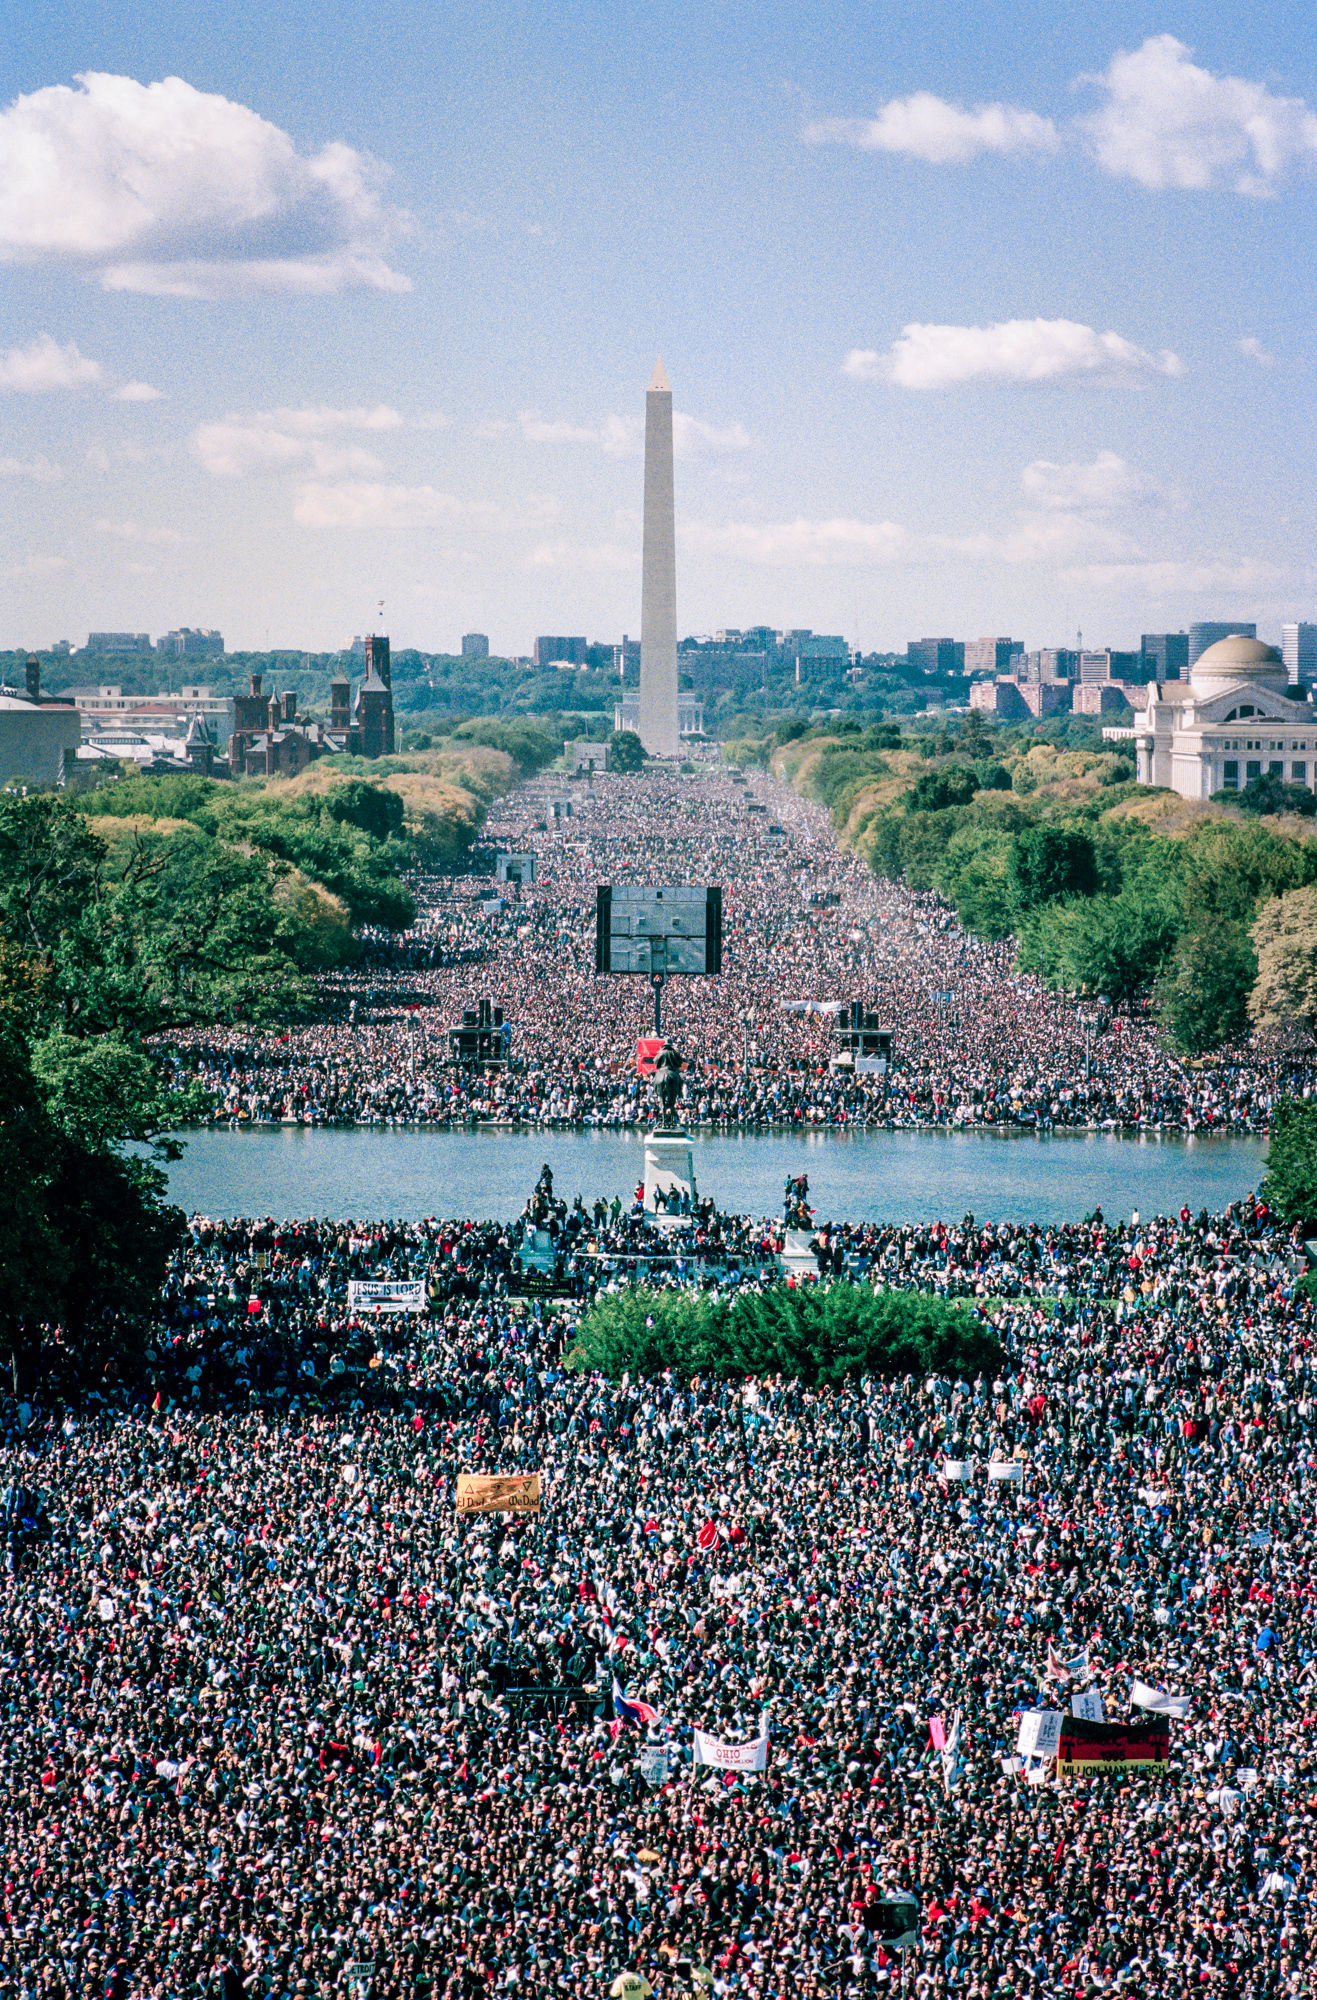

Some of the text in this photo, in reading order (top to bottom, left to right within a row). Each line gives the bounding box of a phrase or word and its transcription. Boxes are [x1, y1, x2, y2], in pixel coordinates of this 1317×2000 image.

[352, 1283, 422, 1296] JESUS IS LORD
[457, 1497, 465, 1507] El
[716, 1749, 740, 1759] OHIO
[1100, 1750, 1126, 1762] 1995
[1062, 1765, 1165, 1776] MILLION MAN MRCH
[347, 1964, 376, 1974] DETROIT
[624, 1984, 641, 1992] STAFF
